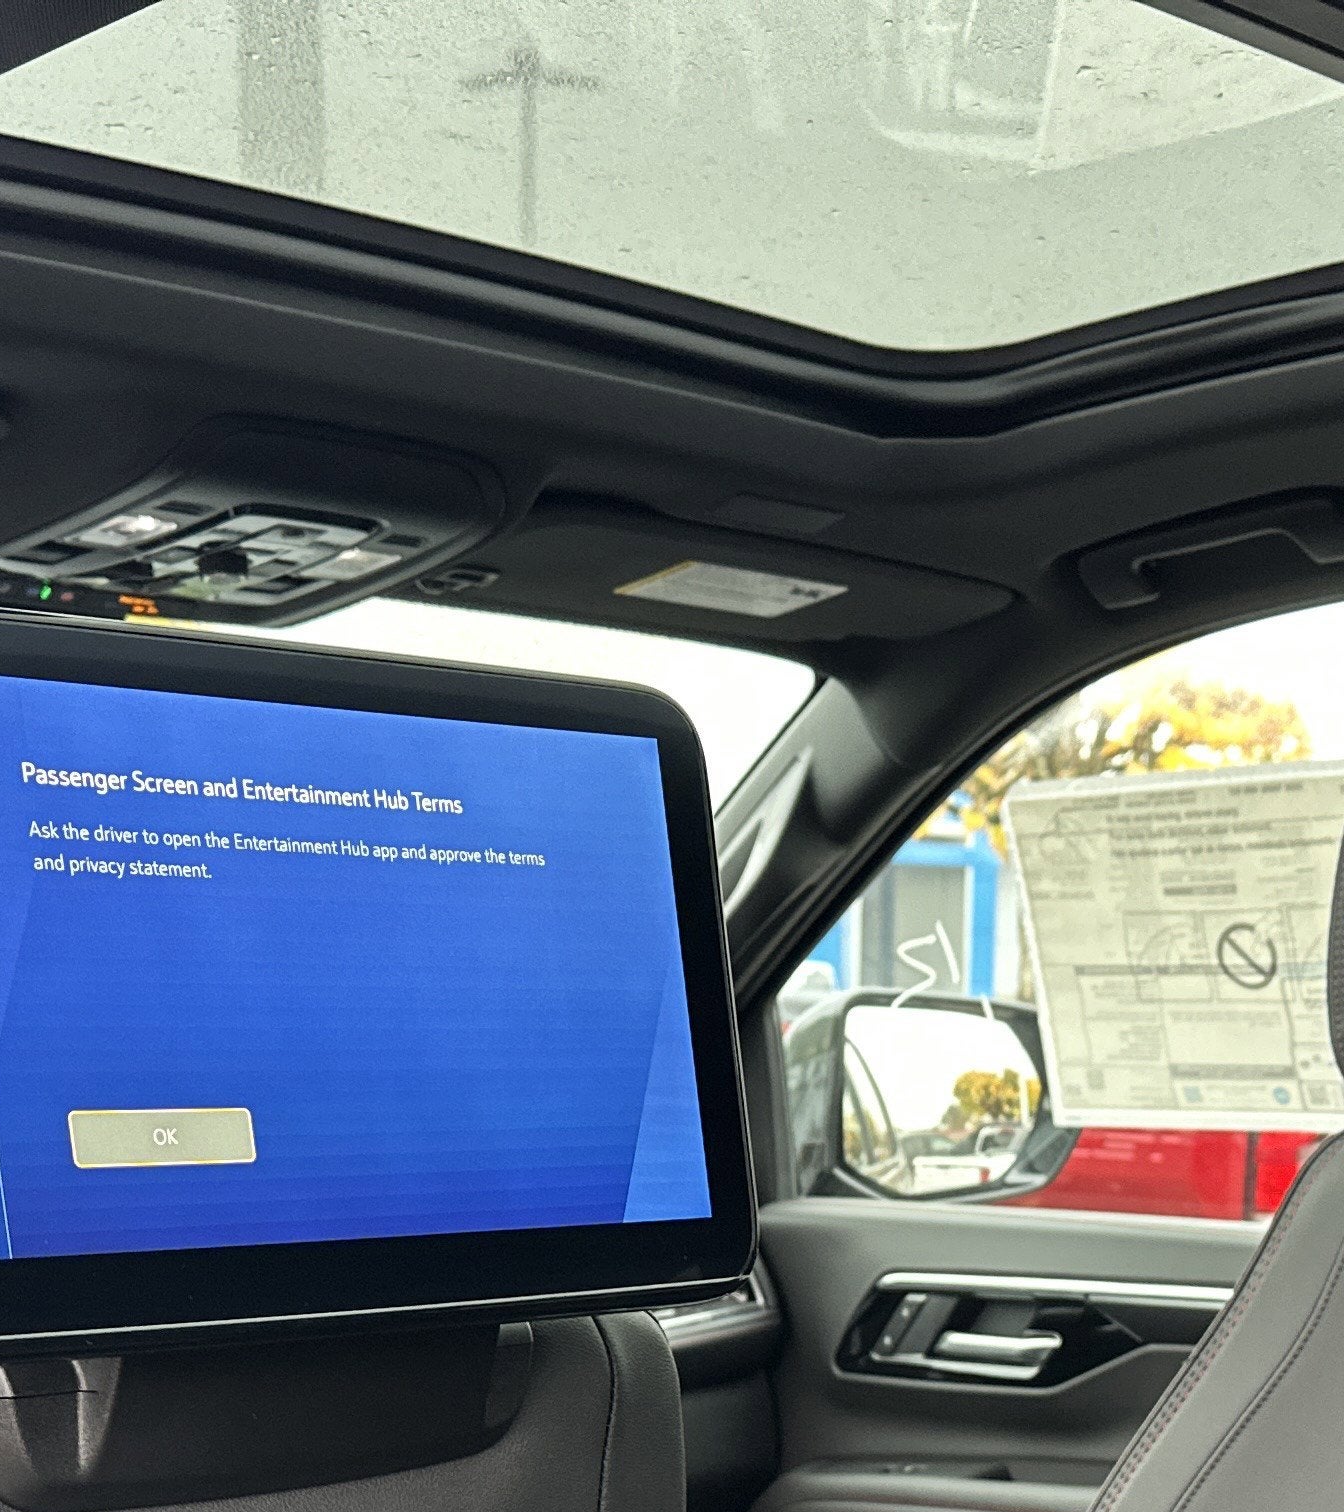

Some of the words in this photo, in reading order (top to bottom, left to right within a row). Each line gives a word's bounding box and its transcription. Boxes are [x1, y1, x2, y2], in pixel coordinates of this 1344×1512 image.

[21, 761, 128, 795] Passenger
[132, 770, 198, 796] Screen
[203, 777, 238, 798] and
[242, 779, 372, 808] Entertainment
[374, 788, 409, 810] Hub
[411, 791, 463, 815] Terms
[29, 820, 59, 839] Ask
[62, 822, 90, 841] the
[94, 824, 138, 844] driver
[142, 828, 159, 845] to
[163, 832, 201, 850] open
[205, 831, 230, 849] the
[234, 833, 338, 855] Entertainment
[340, 839, 370, 857] Hub
[372, 844, 399, 863] app
[401, 844, 427, 860] and
[429, 848, 482, 865] approve
[485, 847, 506, 864] the
[508, 851, 546, 867] terms
[33, 853, 65, 871] and
[69, 856, 125, 879] privacy
[129, 859, 213, 879] statement.
[153, 1128, 179, 1146] OK
